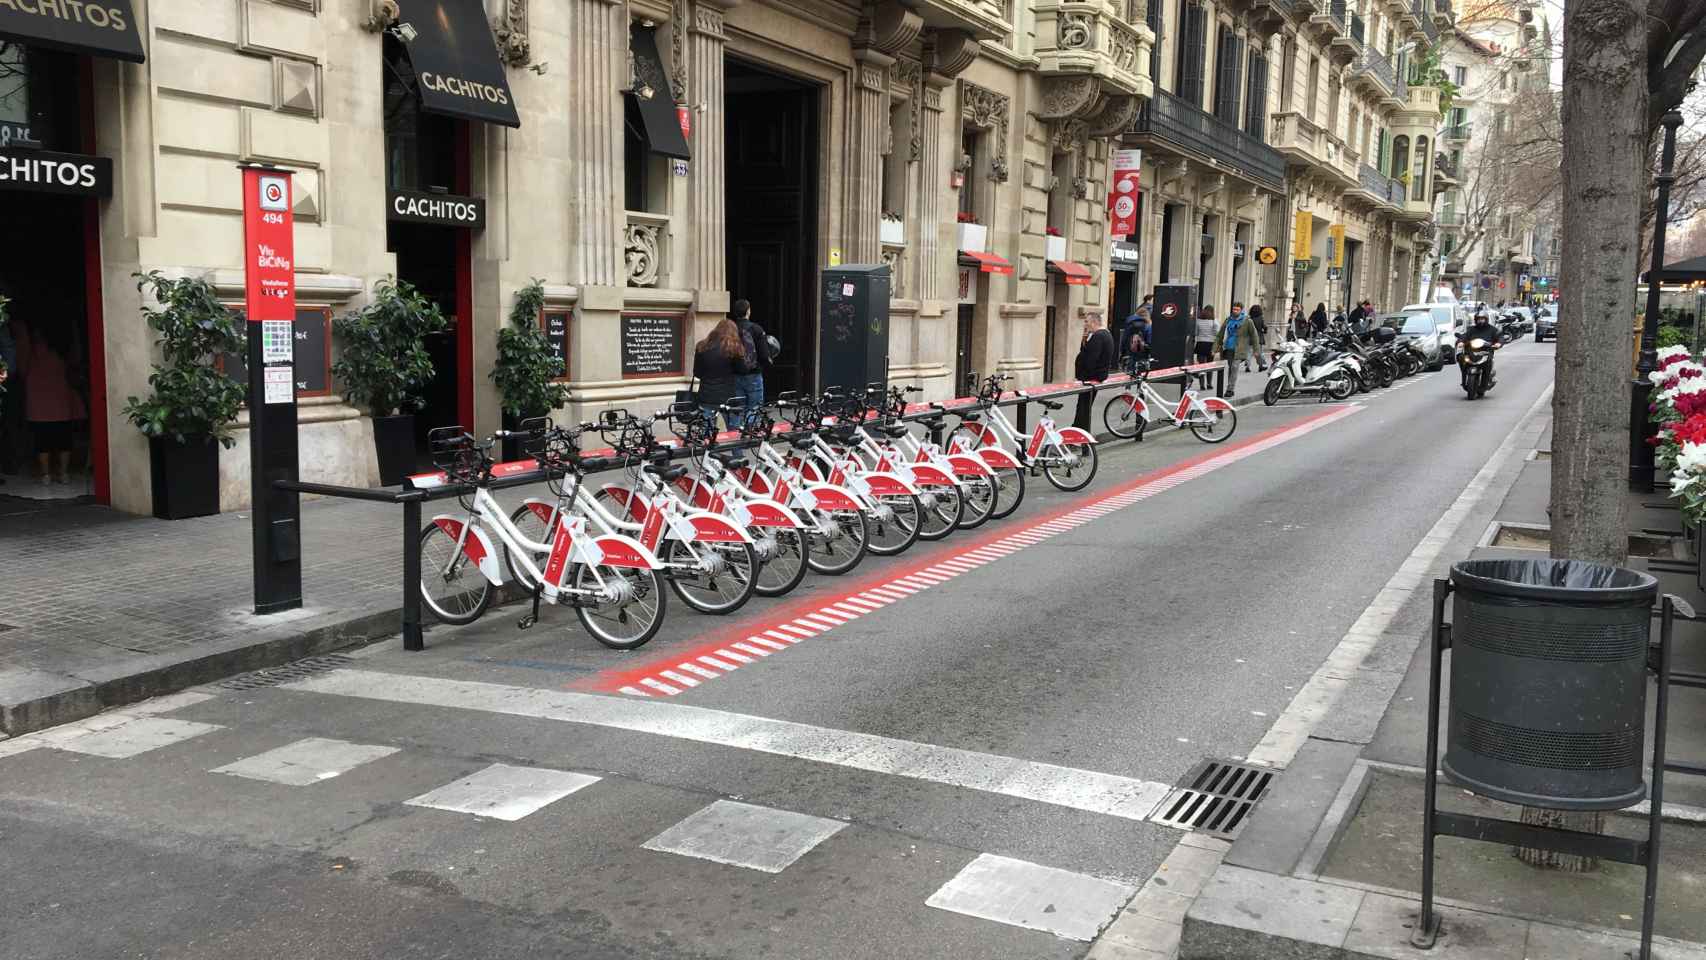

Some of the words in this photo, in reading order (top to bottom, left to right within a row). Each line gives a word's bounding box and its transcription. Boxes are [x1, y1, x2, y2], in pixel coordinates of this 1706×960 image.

[421, 71, 508, 105] CACHITOS
[262, 213, 283, 224] 494
[394, 196, 477, 221] CACHITOS
